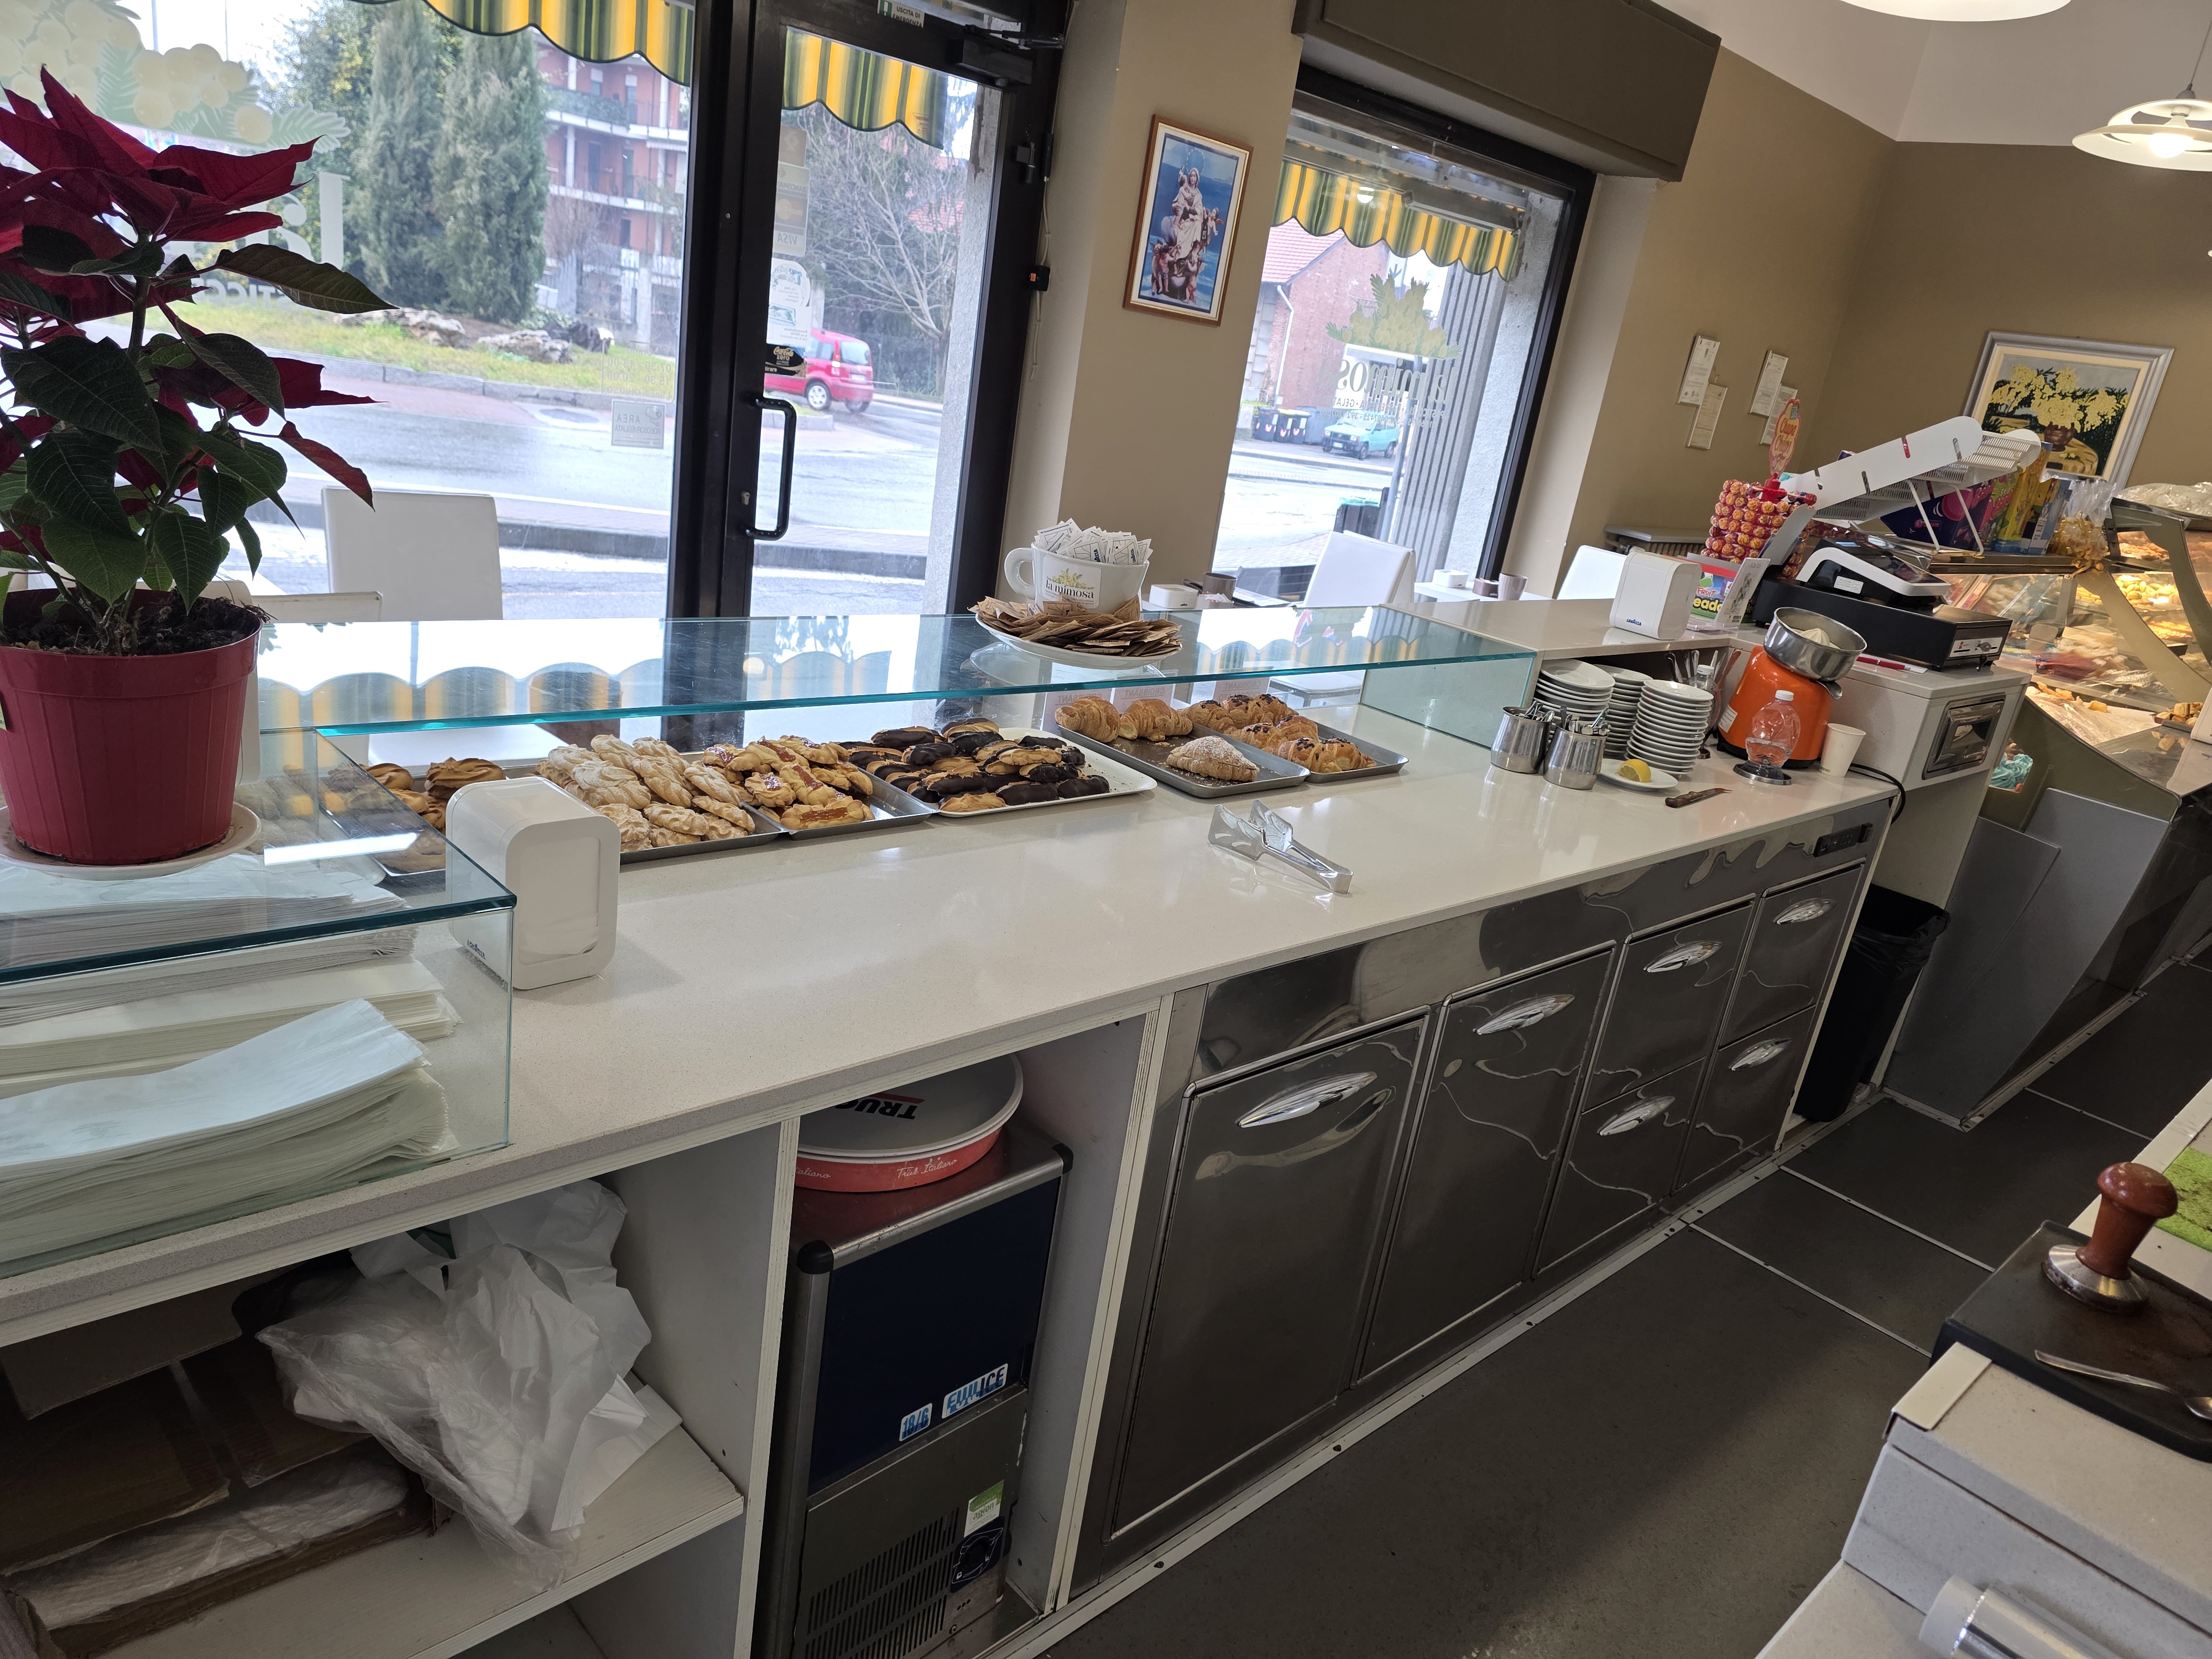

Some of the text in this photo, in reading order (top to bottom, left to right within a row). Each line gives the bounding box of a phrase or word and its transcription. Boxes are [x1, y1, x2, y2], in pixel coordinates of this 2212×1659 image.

[893, 13, 922, 27] EMERGENZA
[896, 6, 914, 17] USCITA
[1780, 418, 1797, 439] Chupa
[1774, 434, 1792, 455] Chups
[1046, 579, 1053, 591] la
[1055, 585, 1094, 599] mimosa
[901, 1407, 929, 1440] 18/6
[973, 1502, 994, 1520] agion
